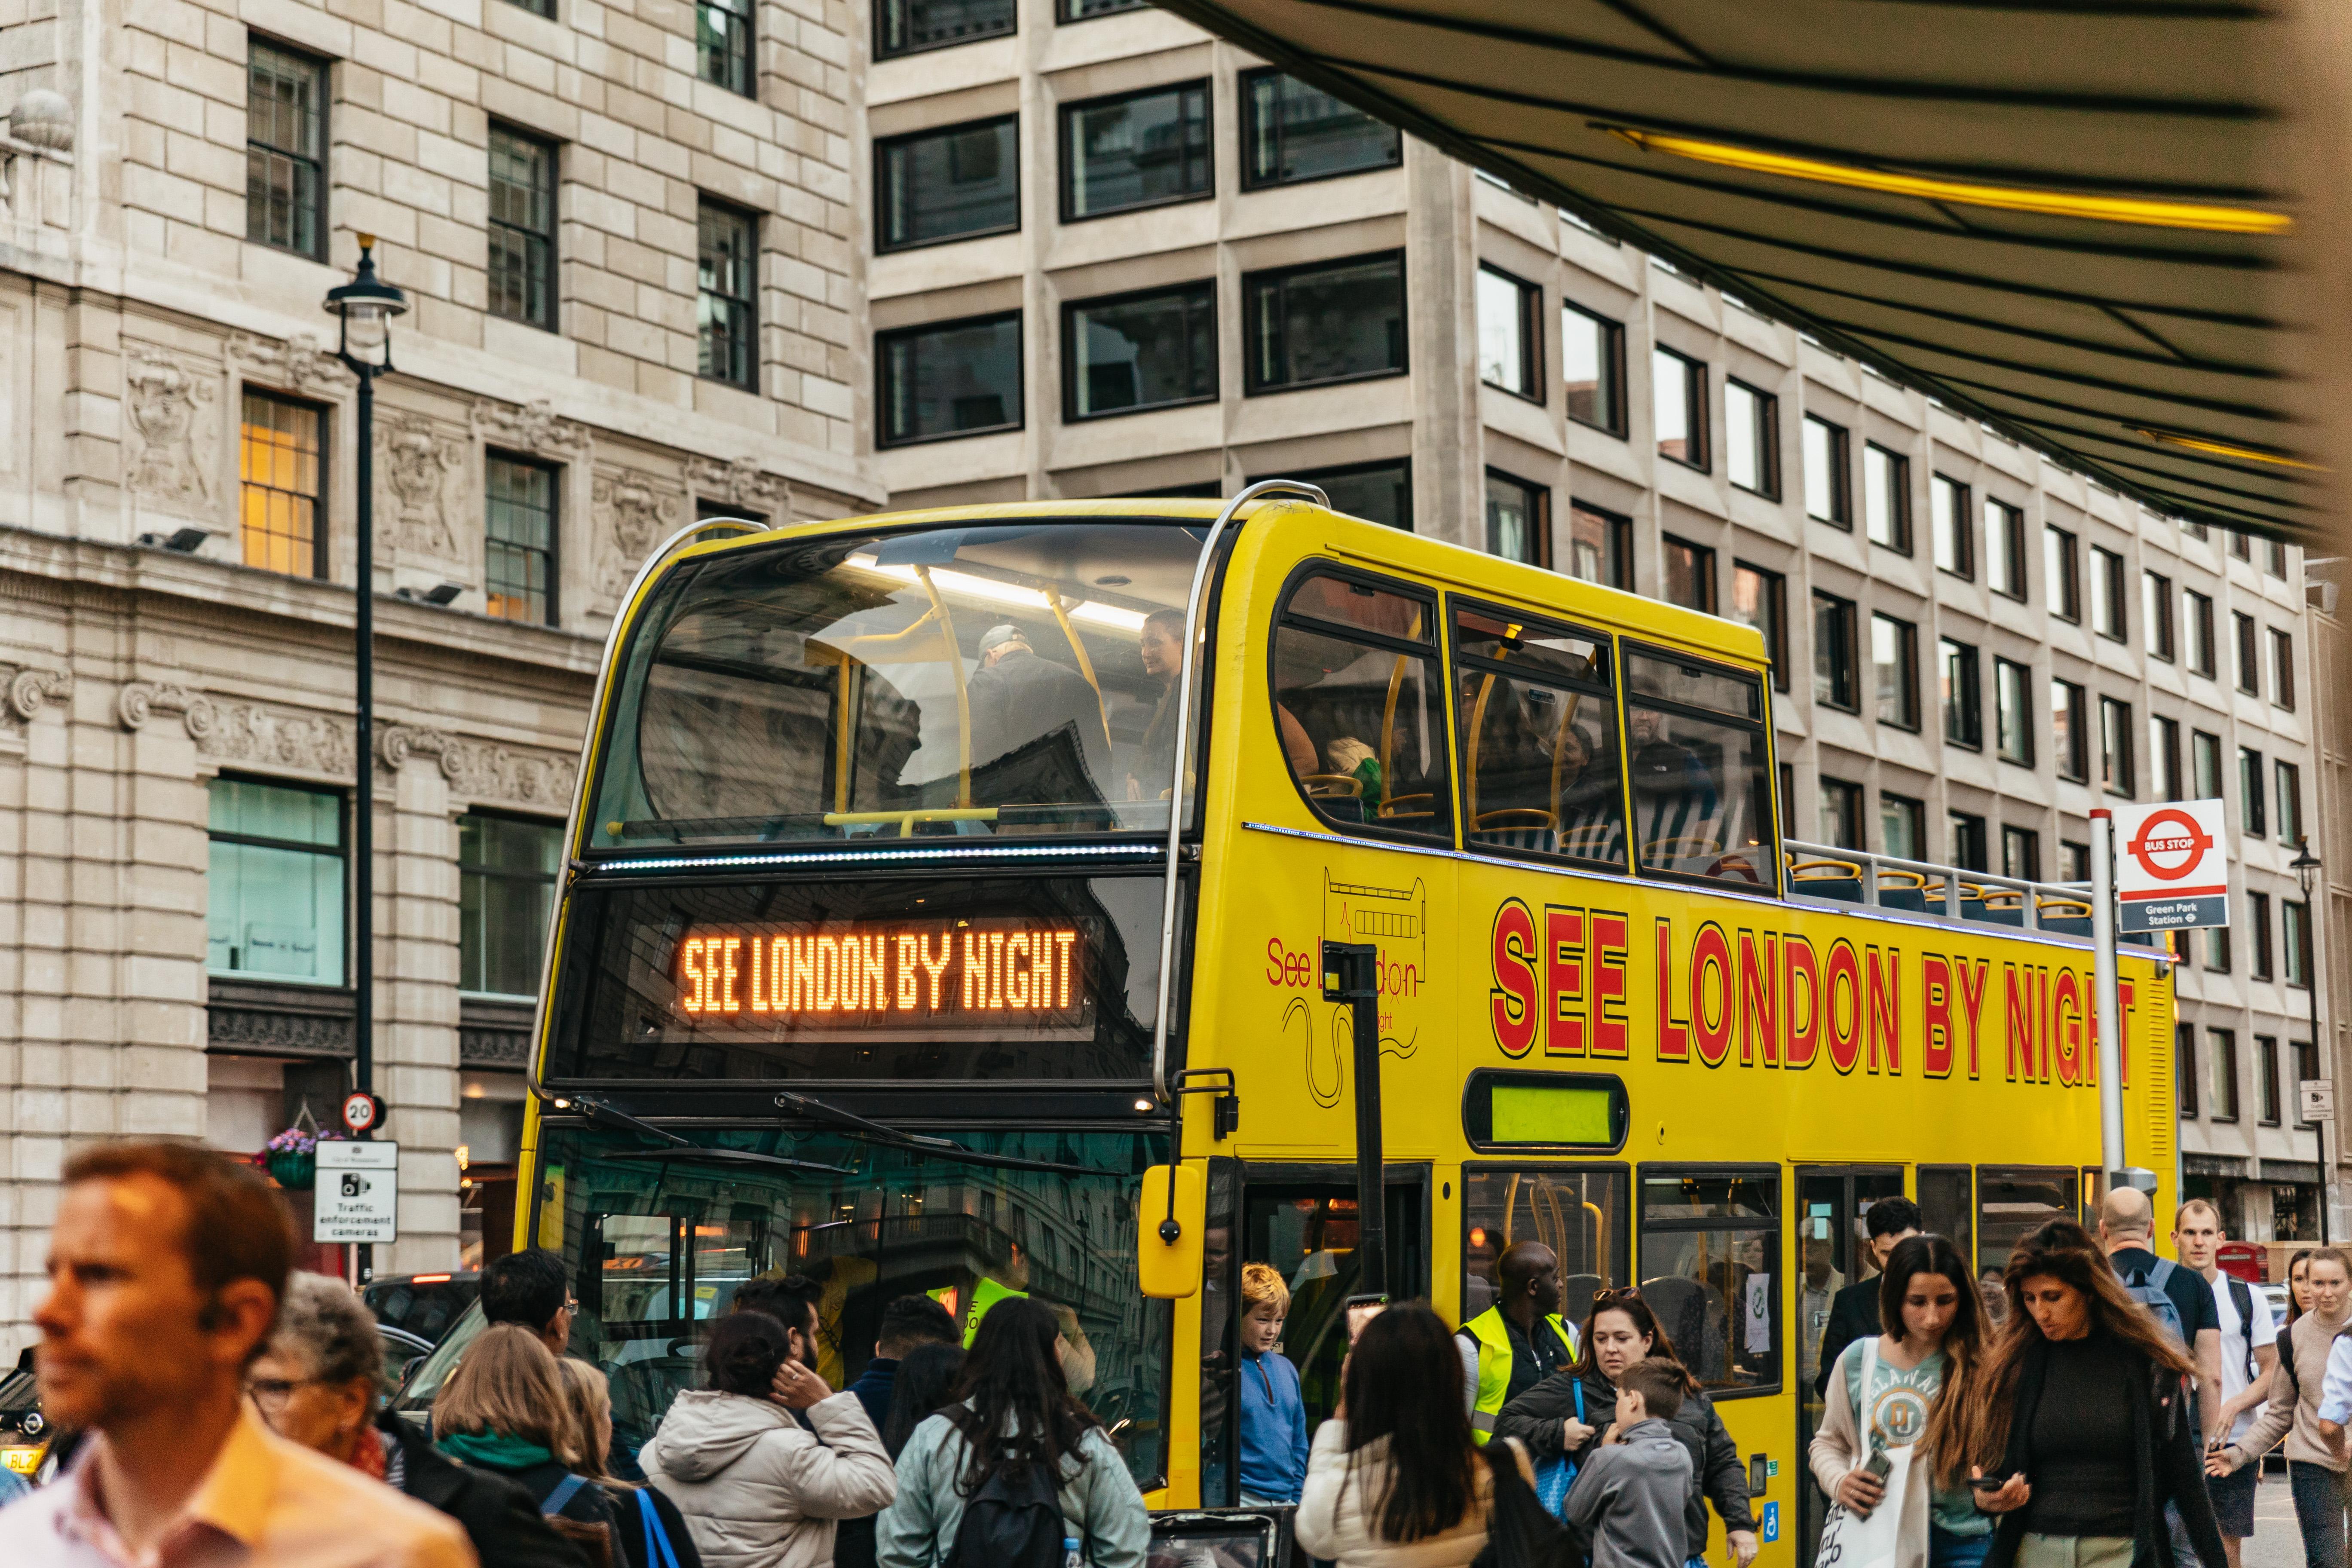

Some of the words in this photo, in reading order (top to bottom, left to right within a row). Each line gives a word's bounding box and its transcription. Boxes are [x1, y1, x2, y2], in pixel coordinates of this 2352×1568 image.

[2144, 841, 2165, 851] BUS
[2167, 838, 2195, 849] STOP
[2145, 905, 2174, 915] Green
[2176, 903, 2197, 912] Park
[2148, 916, 2183, 925] Station
[683, 937, 741, 1011] SEE
[752, 934, 885, 1011] LONDON
[897, 933, 951, 1009] BY
[964, 931, 1075, 1009] NIGHT
[1267, 937, 1311, 988] See
[1317, 936, 1417, 997] Ldon
[1490, 896, 1629, 1061] SEE
[1655, 916, 1902, 1076] LONDON
[1921, 951, 1990, 1081] BY
[1378, 1011, 1393, 1032] ight
[349, 1104, 369, 1118] 20
[337, 1203, 373, 1212] Traffic
[320, 1215, 390, 1224] enforcement
[1869, 1369, 1939, 1408] ELAWA
